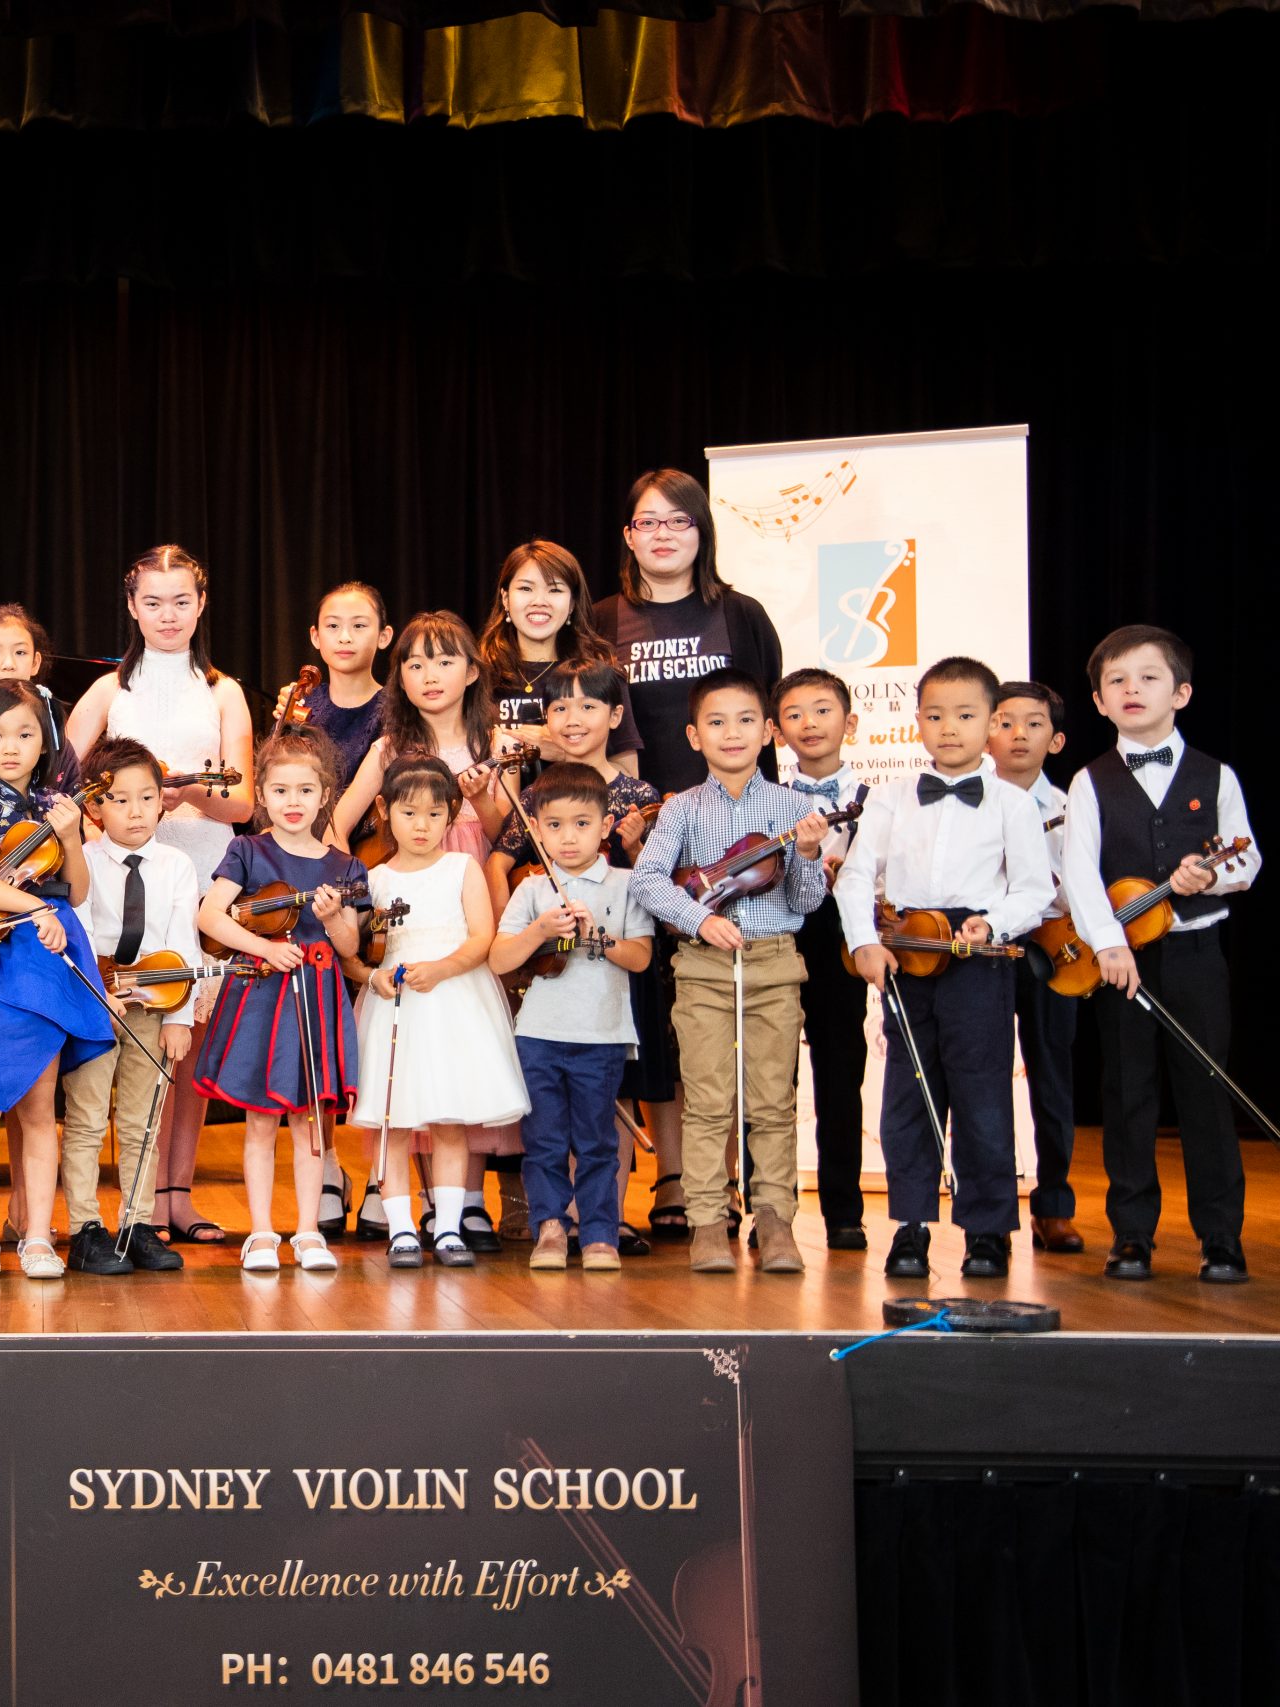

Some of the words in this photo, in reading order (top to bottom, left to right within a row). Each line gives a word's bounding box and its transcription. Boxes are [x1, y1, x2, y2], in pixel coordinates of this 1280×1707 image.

[631, 637, 700, 661] SYDNEY
[848, 683, 907, 699] IOLIN
[869, 725, 923, 745] with
[851, 760, 863, 770] to
[867, 757, 904, 769] Violin
[70, 1468, 270, 1510] SYDNEY
[292, 1468, 468, 1510] VIOLIN
[493, 1467, 698, 1510] SCHOOL
[188, 1559, 379, 1597] Excellence
[388, 1559, 465, 1597] with
[472, 1559, 580, 1611] Effort
[221, 1653, 288, 1685] PH:
[311, 1653, 399, 1685] 0481
[409, 1653, 475, 1685] 846
[484, 1653, 550, 1685] 546
